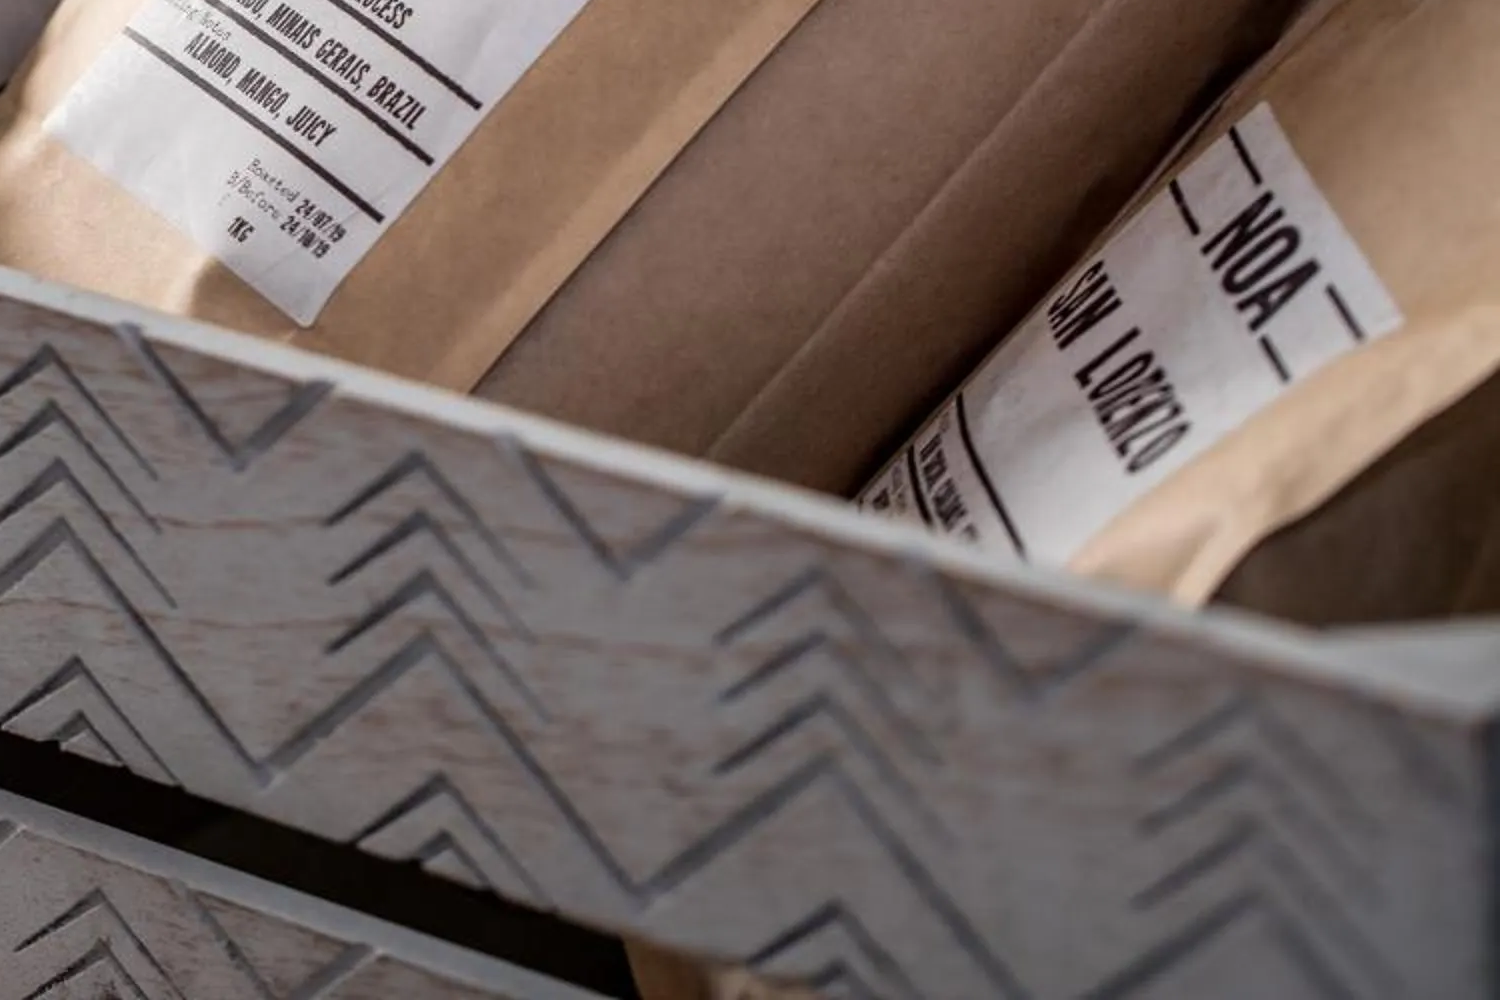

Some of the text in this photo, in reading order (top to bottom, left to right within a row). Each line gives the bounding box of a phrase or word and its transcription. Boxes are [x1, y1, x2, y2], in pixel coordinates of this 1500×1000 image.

[184, 32, 337, 147] ALMOND, MANGO, JUICY
[266, 3, 321, 51] MINAIS
[316, 38, 371, 91] GERAIS,
[366, 76, 427, 131] BRAZIL
[227, 216, 255, 243] 1KG
[1200, 190, 1320, 332] NOA
[1047, 260, 1193, 475] SAN LORENZO
